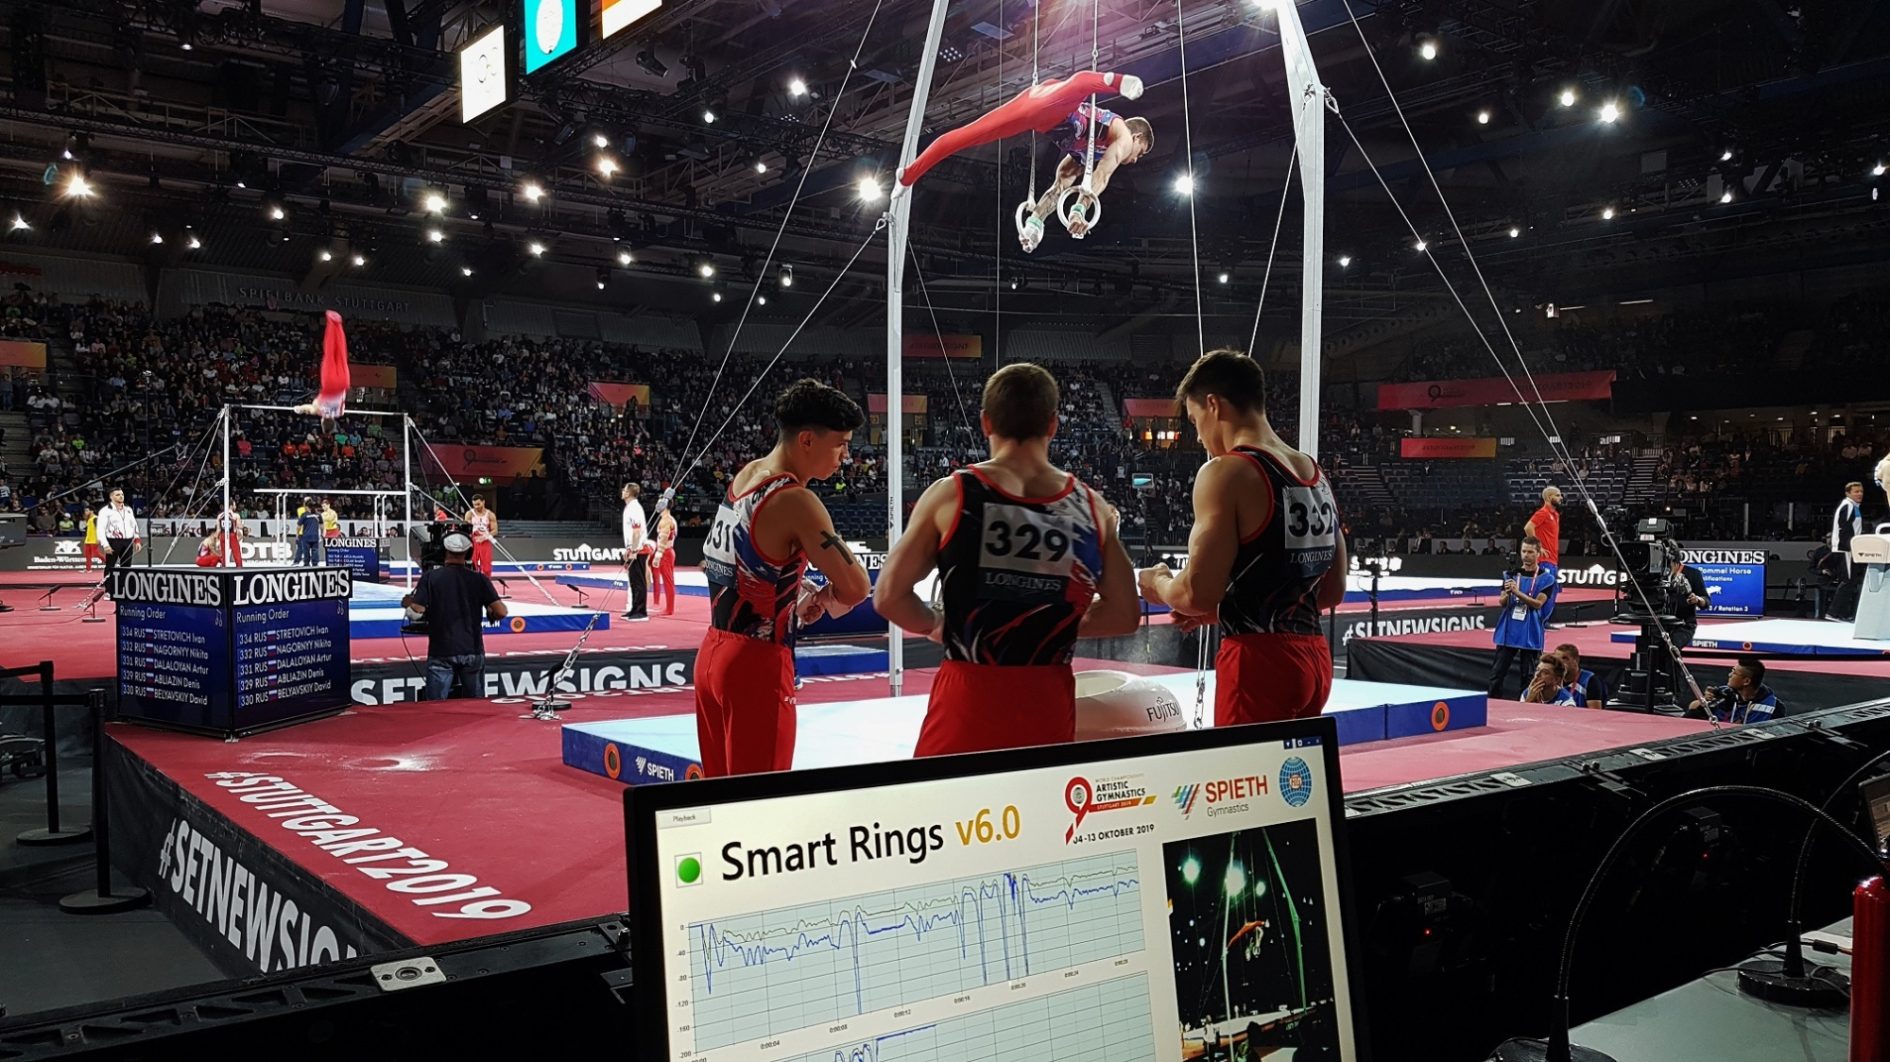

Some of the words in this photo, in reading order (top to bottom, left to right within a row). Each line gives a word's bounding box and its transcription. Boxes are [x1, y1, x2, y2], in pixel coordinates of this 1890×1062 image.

[239, 288, 325, 305] SPIELBANK
[335, 297, 410, 313] STUTTGART
[1288, 502, 1334, 537] 332
[325, 538, 377, 548] LONGINES
[985, 521, 1069, 562] 329
[1290, 550, 1333, 564] LONGINES
[1680, 550, 1765, 565] ONGINES
[705, 561, 733, 577] ONGINES
[1729, 566, 1752, 575] Horse
[113, 571, 221, 607] LONGINES
[233, 569, 350, 606] LONGINES
[985, 572, 1061, 591] LONGINES
[120, 605, 145, 620] Running
[146, 607, 166, 619] Order
[236, 611, 266, 624] Running
[268, 608, 290, 619] Order
[1718, 605, 1744, 613] Rotation
[122, 626, 133, 637] 334
[134, 628, 146, 638] RUS
[153, 630, 191, 643] STRETOVICH
[192, 633, 205, 644] Ivan
[240, 633, 252, 645] 334
[254, 631, 267, 643] RUS
[276, 626, 315, 640] STRETOVICH
[316, 625, 329, 634] Ivan
[1692, 640, 1718, 649] SPIETH
[122, 641, 133, 652] 332
[134, 642, 146, 653] RUS
[154, 645, 189, 657] NAGORNYY
[190, 648, 208, 660] Nikita
[240, 648, 253, 660] 332
[254, 646, 268, 658] RUS
[276, 640, 313, 654] NAGORNYY
[314, 639, 332, 649] Nikita
[122, 655, 133, 666] 331
[134, 657, 146, 668] RUS
[154, 659, 191, 672] DALALOYAN
[192, 664, 208, 675] Artur
[240, 664, 253, 676] 331
[254, 661, 268, 673] RUS
[277, 655, 316, 670] DALALOYAN
[317, 653, 332, 663] Artur
[122, 670, 133, 680] 329
[134, 671, 146, 682] RUS
[154, 674, 182, 686] ABLIAZIN
[184, 677, 200, 689] Denis
[240, 679, 253, 691] 329
[255, 676, 268, 689] RUS
[277, 669, 307, 685] ABLIAZIN
[308, 667, 324, 679] Denis
[122, 684, 134, 695] 330
[135, 686, 146, 697] RUS
[154, 689, 188, 702] BELYAVSKIY
[189, 693, 208, 705] David
[241, 695, 254, 707] 330
[255, 692, 269, 704] RUS
[277, 683, 314, 699] BELYAVSKIY
[314, 680, 331, 692] David
[1146, 702, 1180, 722] FUJITSU
[647, 762, 674, 782] SPIETH
[1096, 781, 1129, 792] ARTISTIC
[1096, 788, 1146, 802] GYMNASTICS
[1205, 775, 1268, 803] SPIETH
[672, 813, 697, 823] Playback
[1207, 803, 1249, 818] Gymnastics
[1098, 827, 1134, 841] OKTOBER
[1136, 823, 1155, 834] 2019
[204, 773, 532, 919] #STUTTGART2019
[721, 832, 838, 881] Smart
[849, 822, 945, 864] Rings
[955, 805, 1021, 846] v6.0
[158, 817, 357, 973] #SETNEWSI
